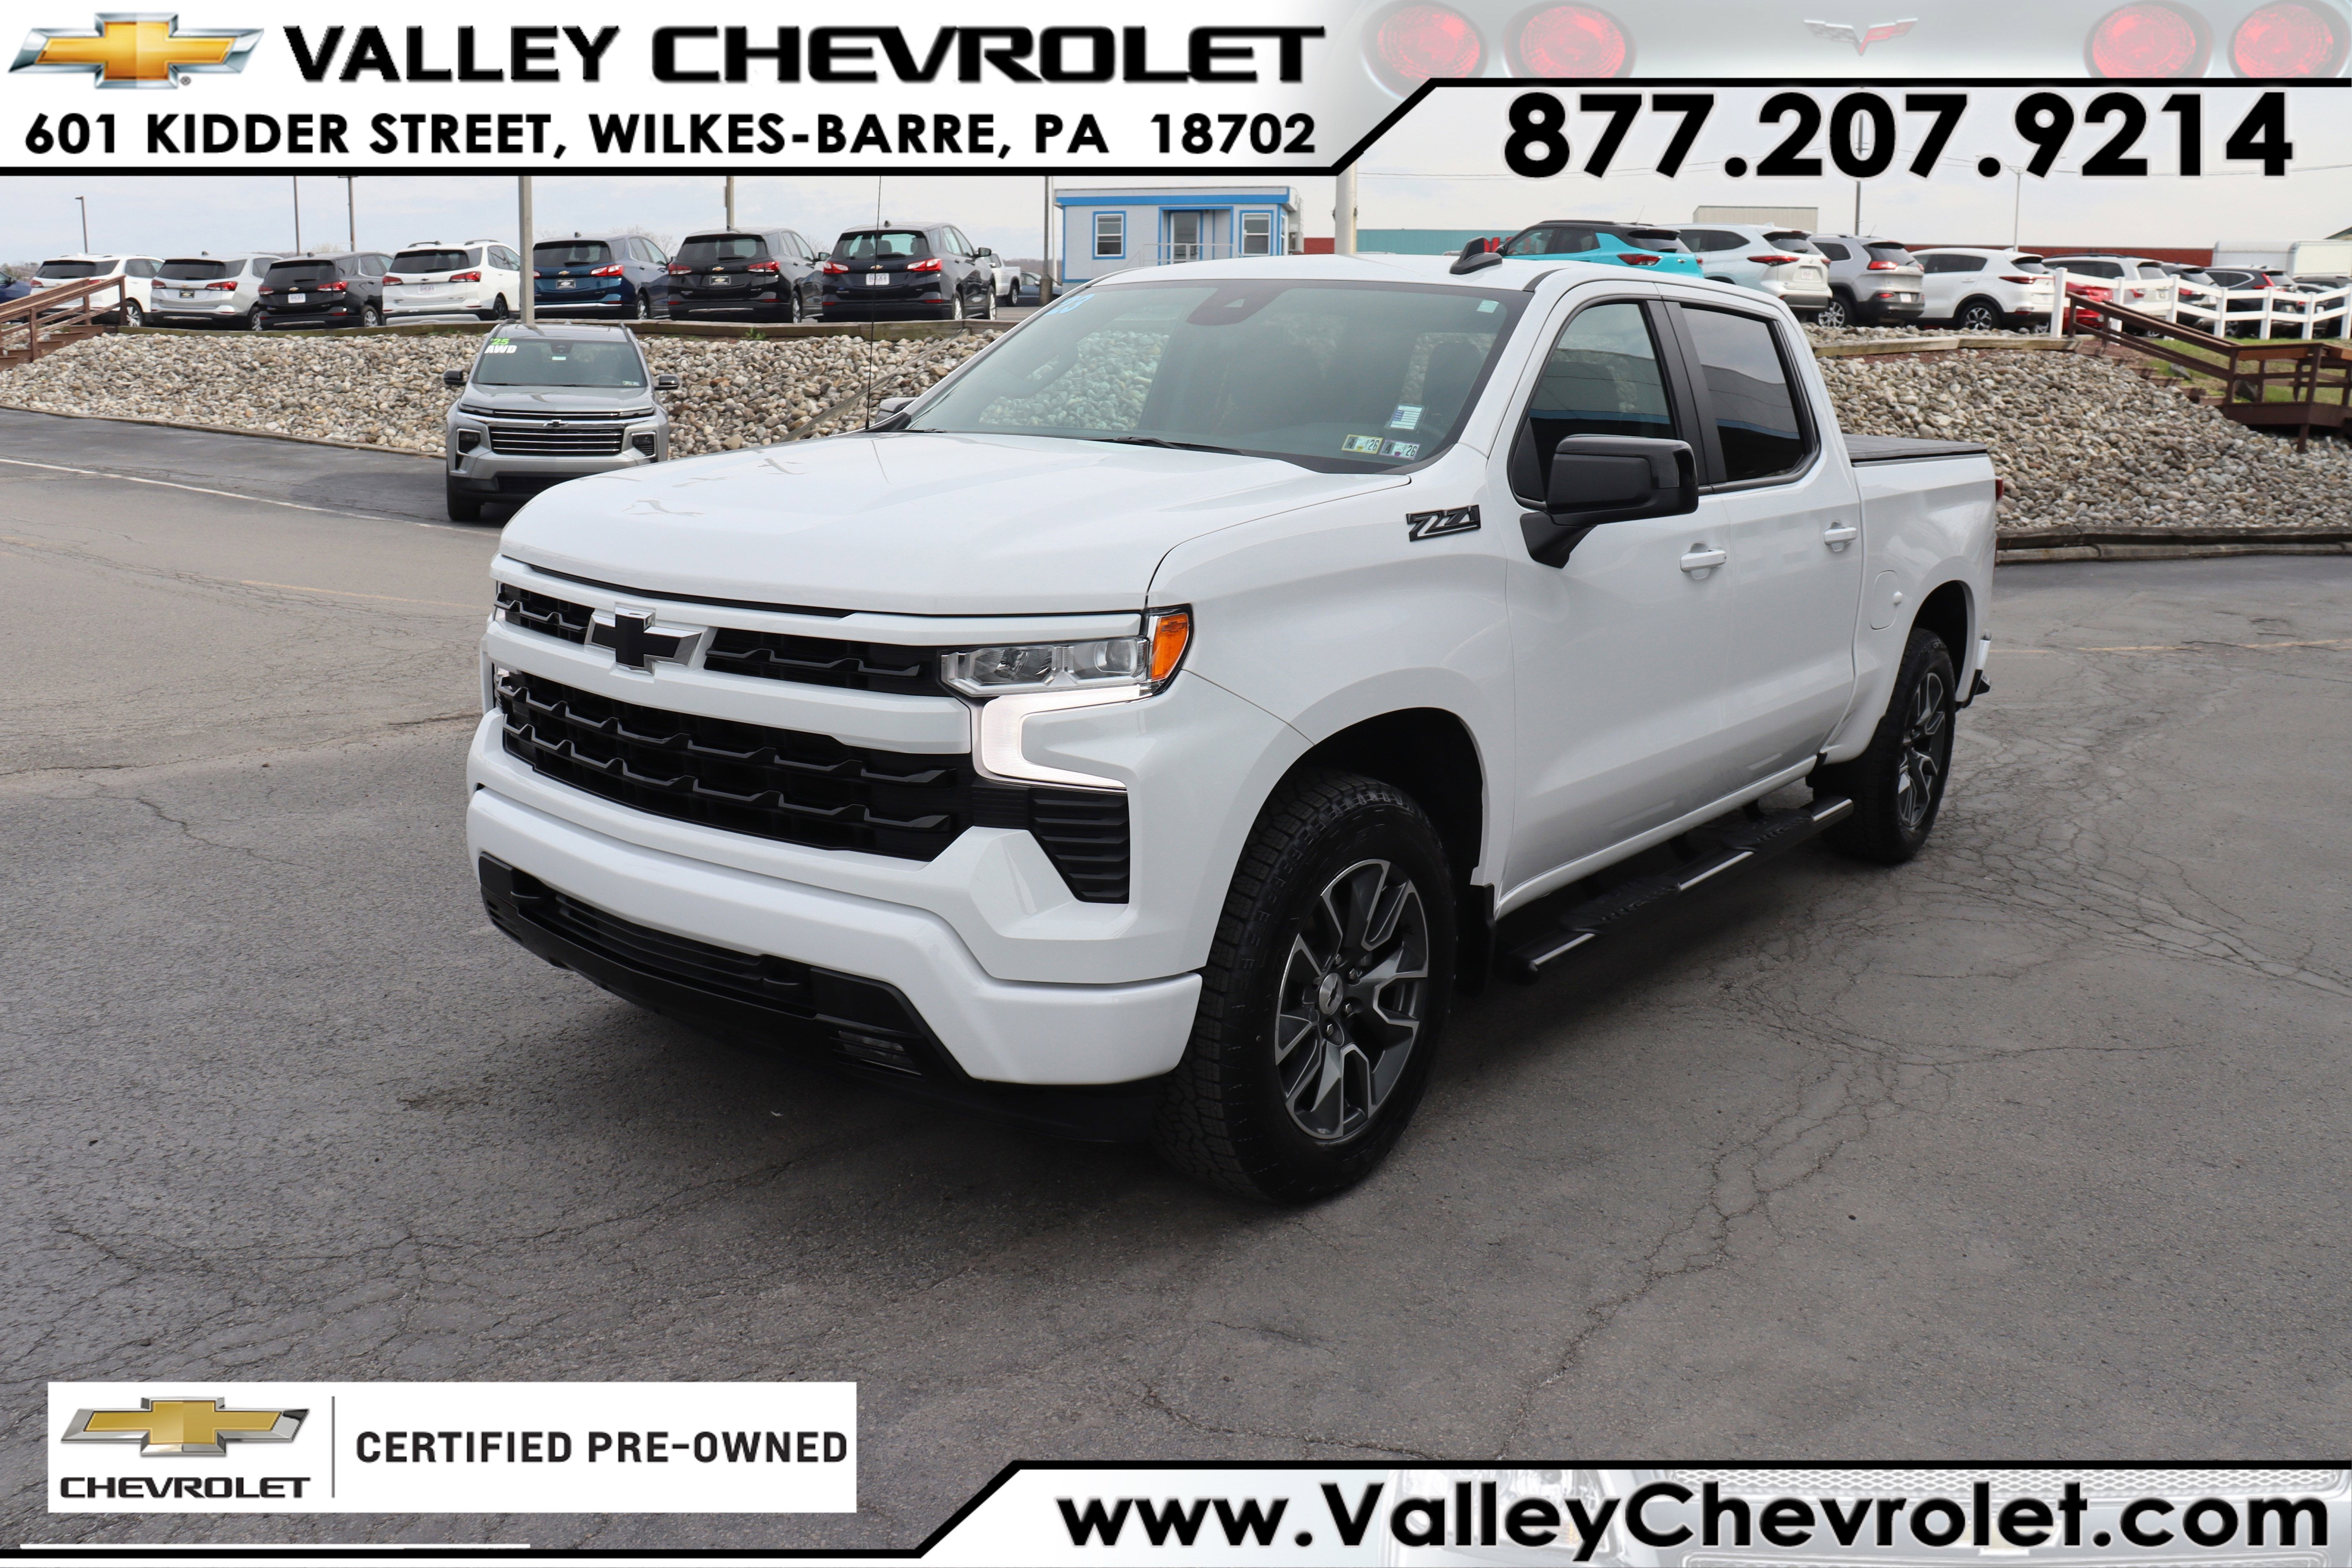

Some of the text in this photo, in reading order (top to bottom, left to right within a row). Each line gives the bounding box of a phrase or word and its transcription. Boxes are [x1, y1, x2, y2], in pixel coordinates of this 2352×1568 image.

[484, 345, 517, 354] AWD
[1368, 439, 1380, 451] 26
[1405, 445, 1417, 457] 26
[1406, 505, 1481, 542] Z71
